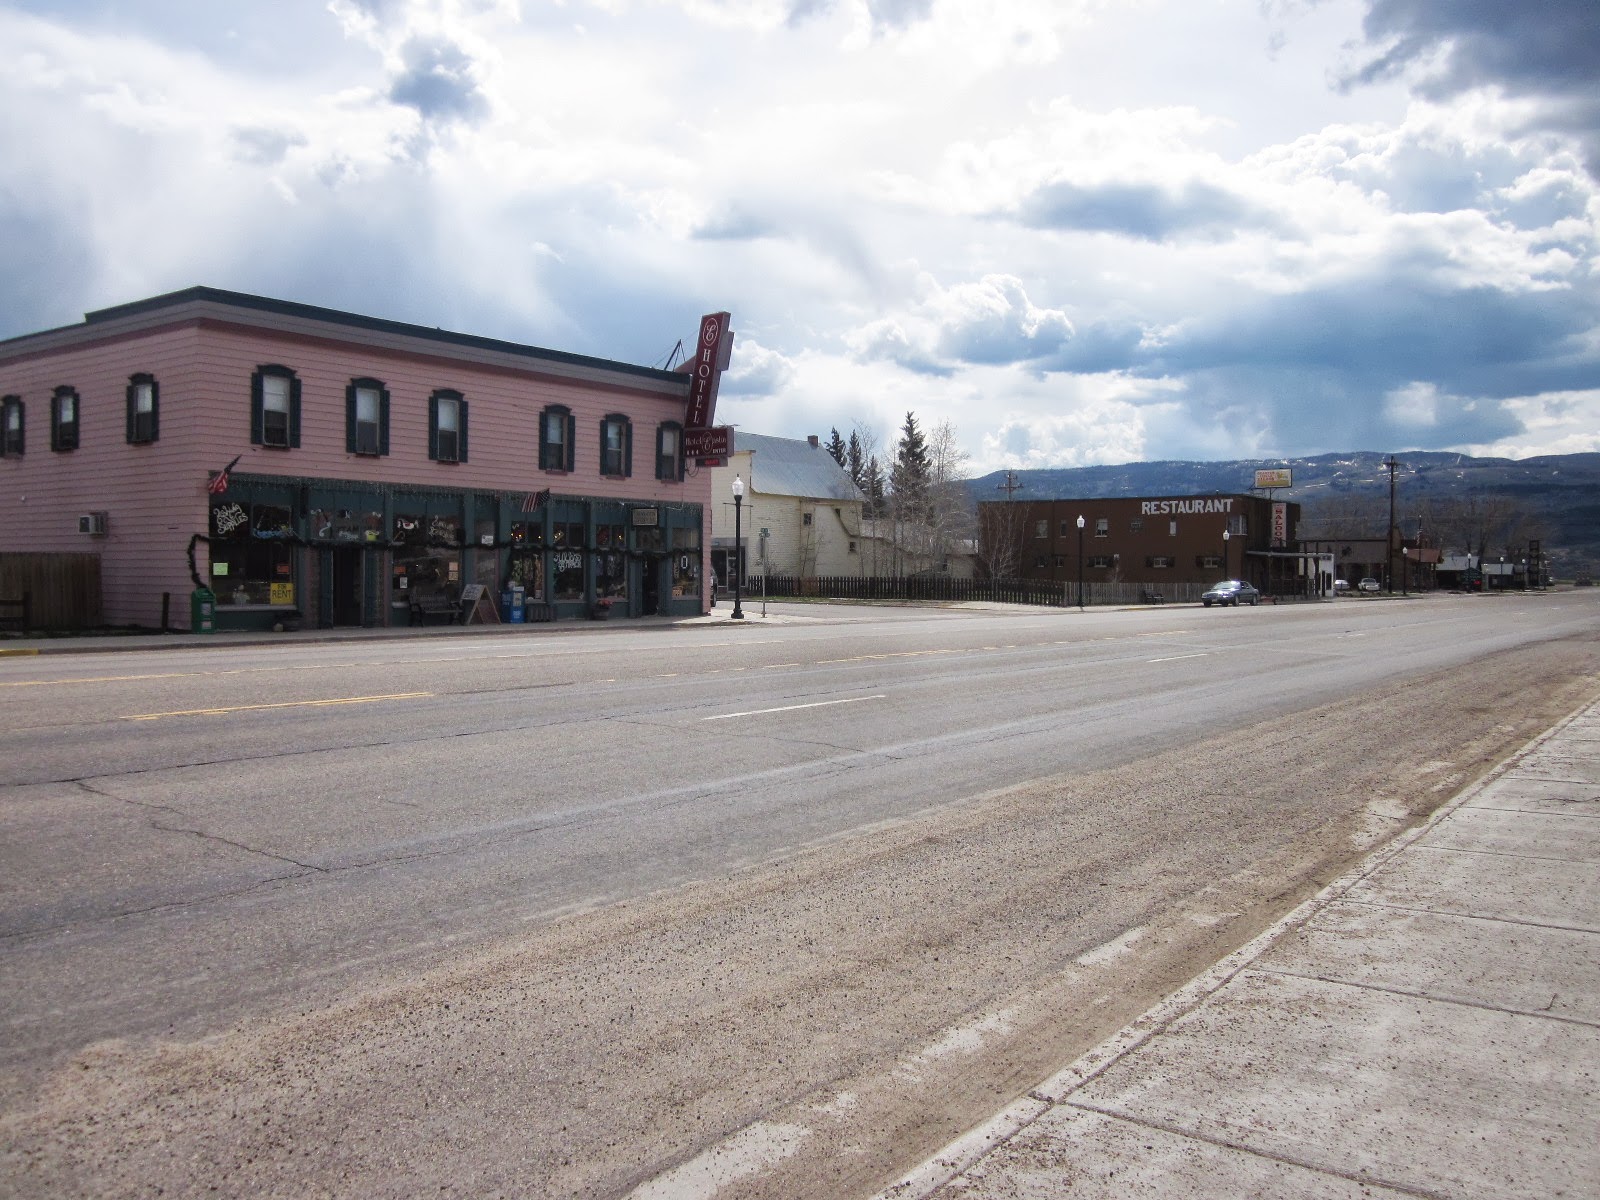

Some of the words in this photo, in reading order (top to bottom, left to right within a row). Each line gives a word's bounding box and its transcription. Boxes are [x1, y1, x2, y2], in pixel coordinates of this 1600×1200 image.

[693, 348, 711, 424] HOTEL
[685, 436, 702, 446] Hotel
[1141, 498, 1234, 515] RESTAURANT
[1273, 509, 1283, 543] SALOON
[271, 589, 292, 599] RENT
